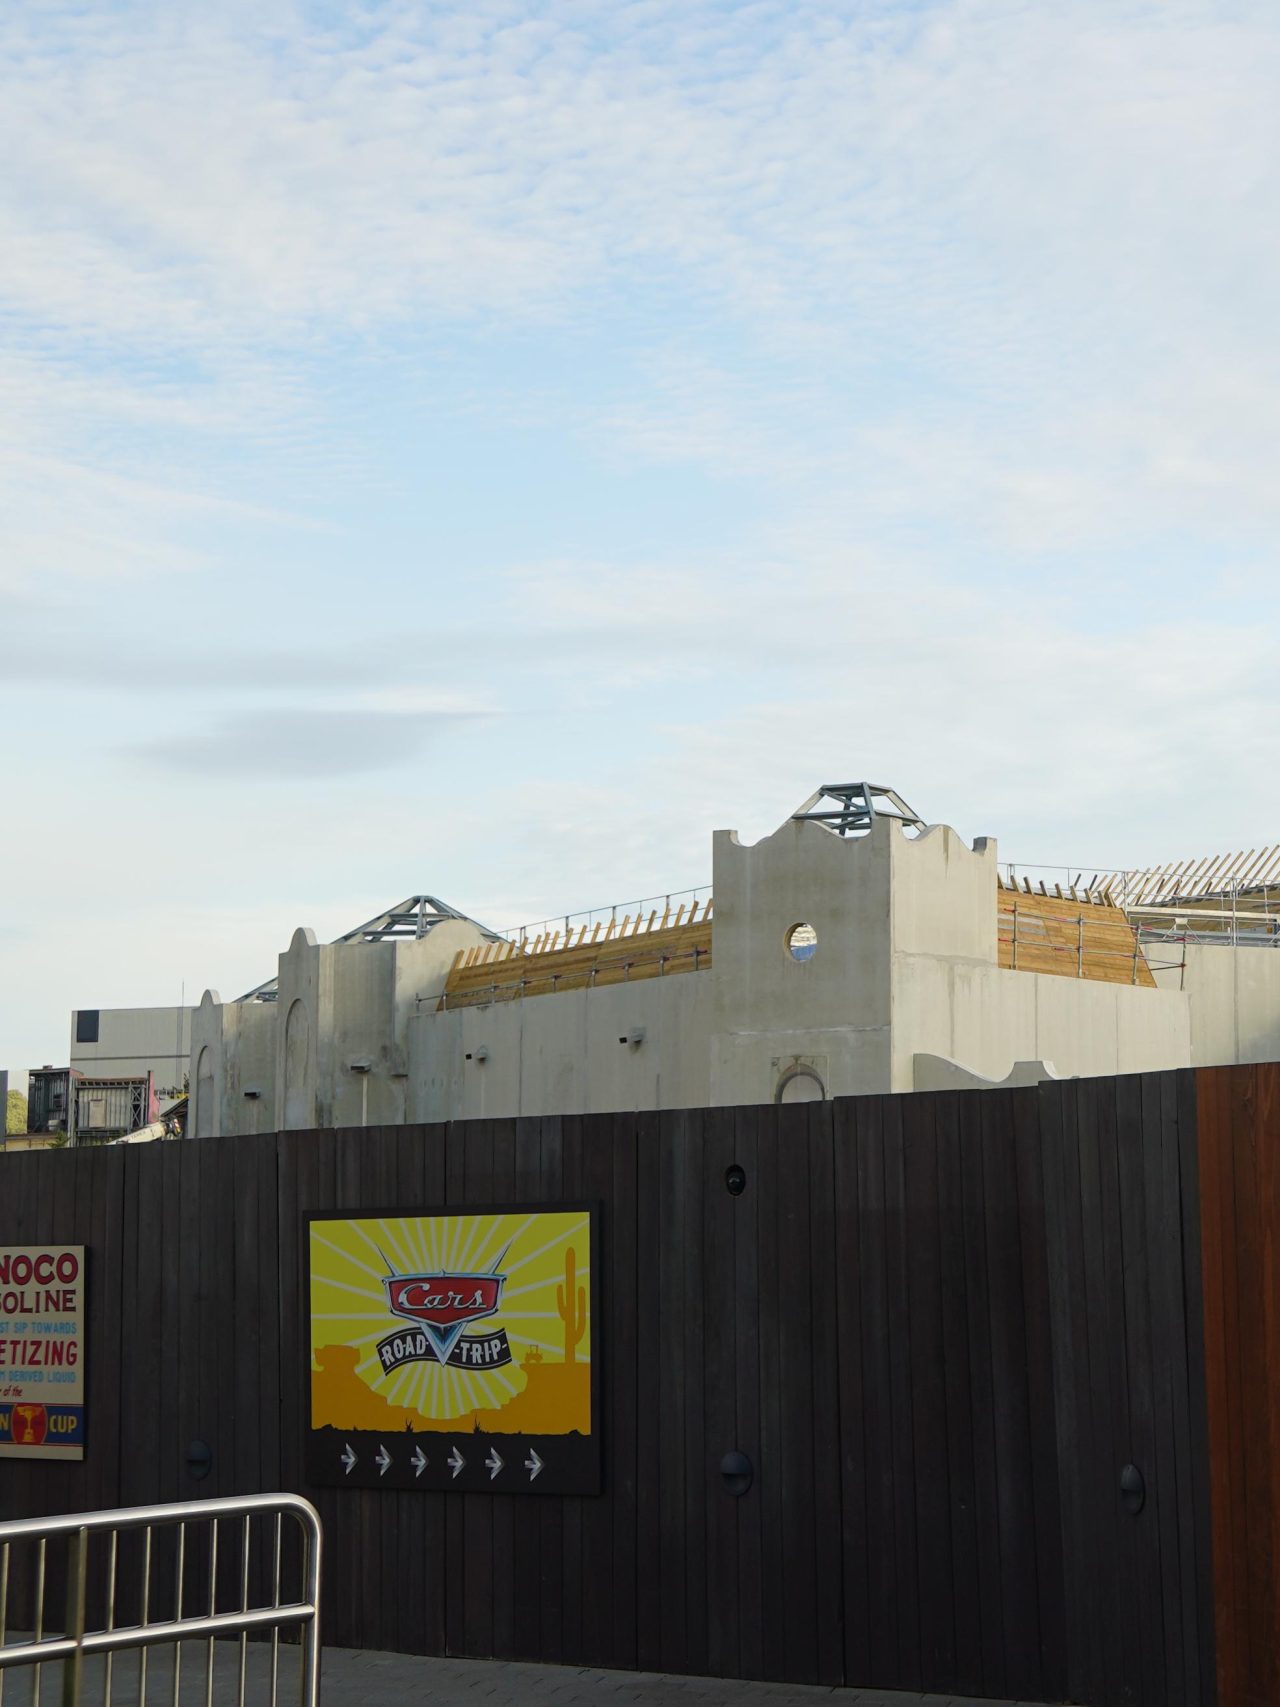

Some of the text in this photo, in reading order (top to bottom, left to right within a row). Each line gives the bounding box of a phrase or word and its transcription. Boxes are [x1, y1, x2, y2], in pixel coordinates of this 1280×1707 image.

[0, 1289, 77, 1314] OLINE
[398, 1283, 487, 1309] Cars
[32, 1321, 77, 1334] TOWARDS
[382, 1334, 502, 1367] ROAD TRIP
[9, 1371, 44, 1382] DERIVED
[48, 1371, 76, 1383] LIQUID
[13, 1385, 23, 1396] the
[49, 1415, 77, 1433] CUP
